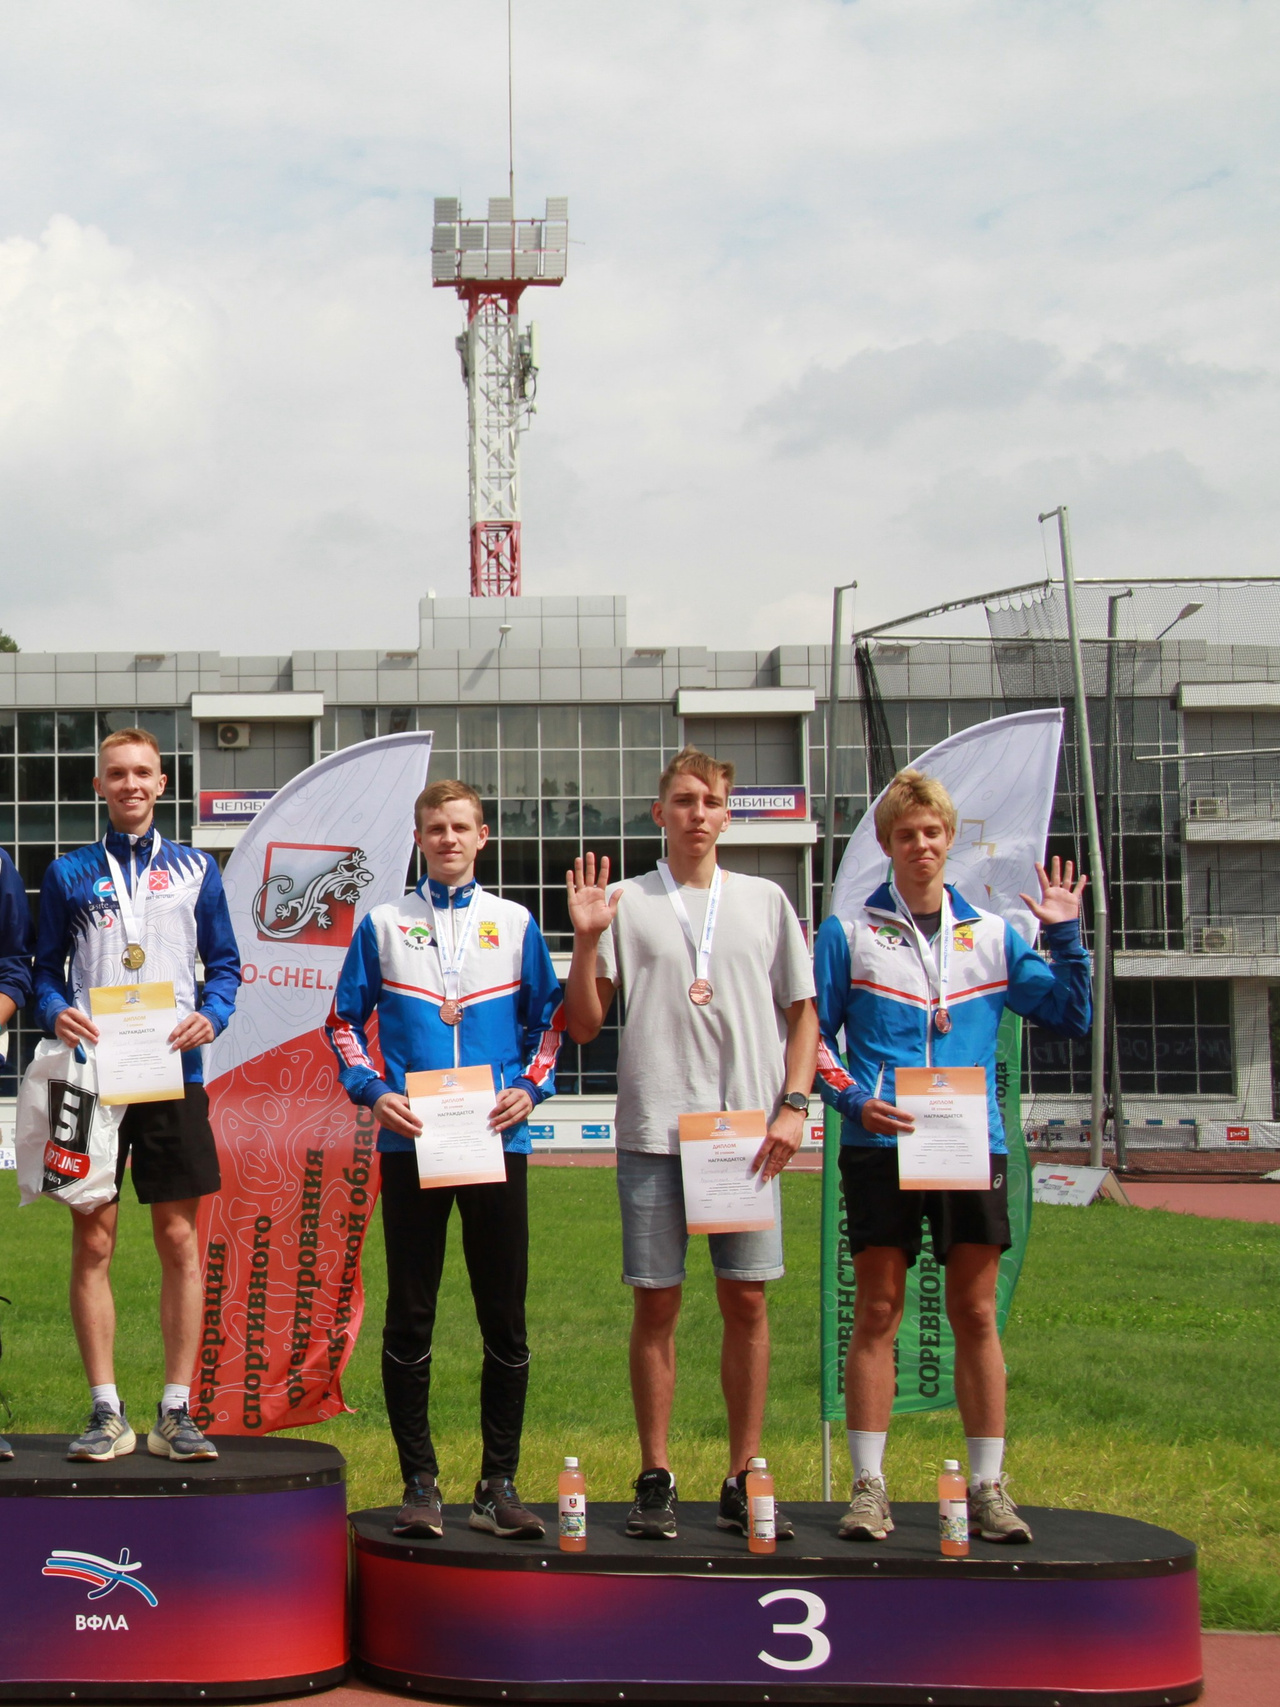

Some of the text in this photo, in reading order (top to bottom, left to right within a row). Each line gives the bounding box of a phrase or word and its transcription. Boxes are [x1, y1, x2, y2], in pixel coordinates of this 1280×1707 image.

[215, 801, 266, 811] ЧЕЛЯБ
[240, 963, 341, 990] O-CHEL.
[242, 1215, 272, 1430] спортивного
[75, 1614, 129, 1631] ВФЛА
[757, 1588, 831, 1671] 3
